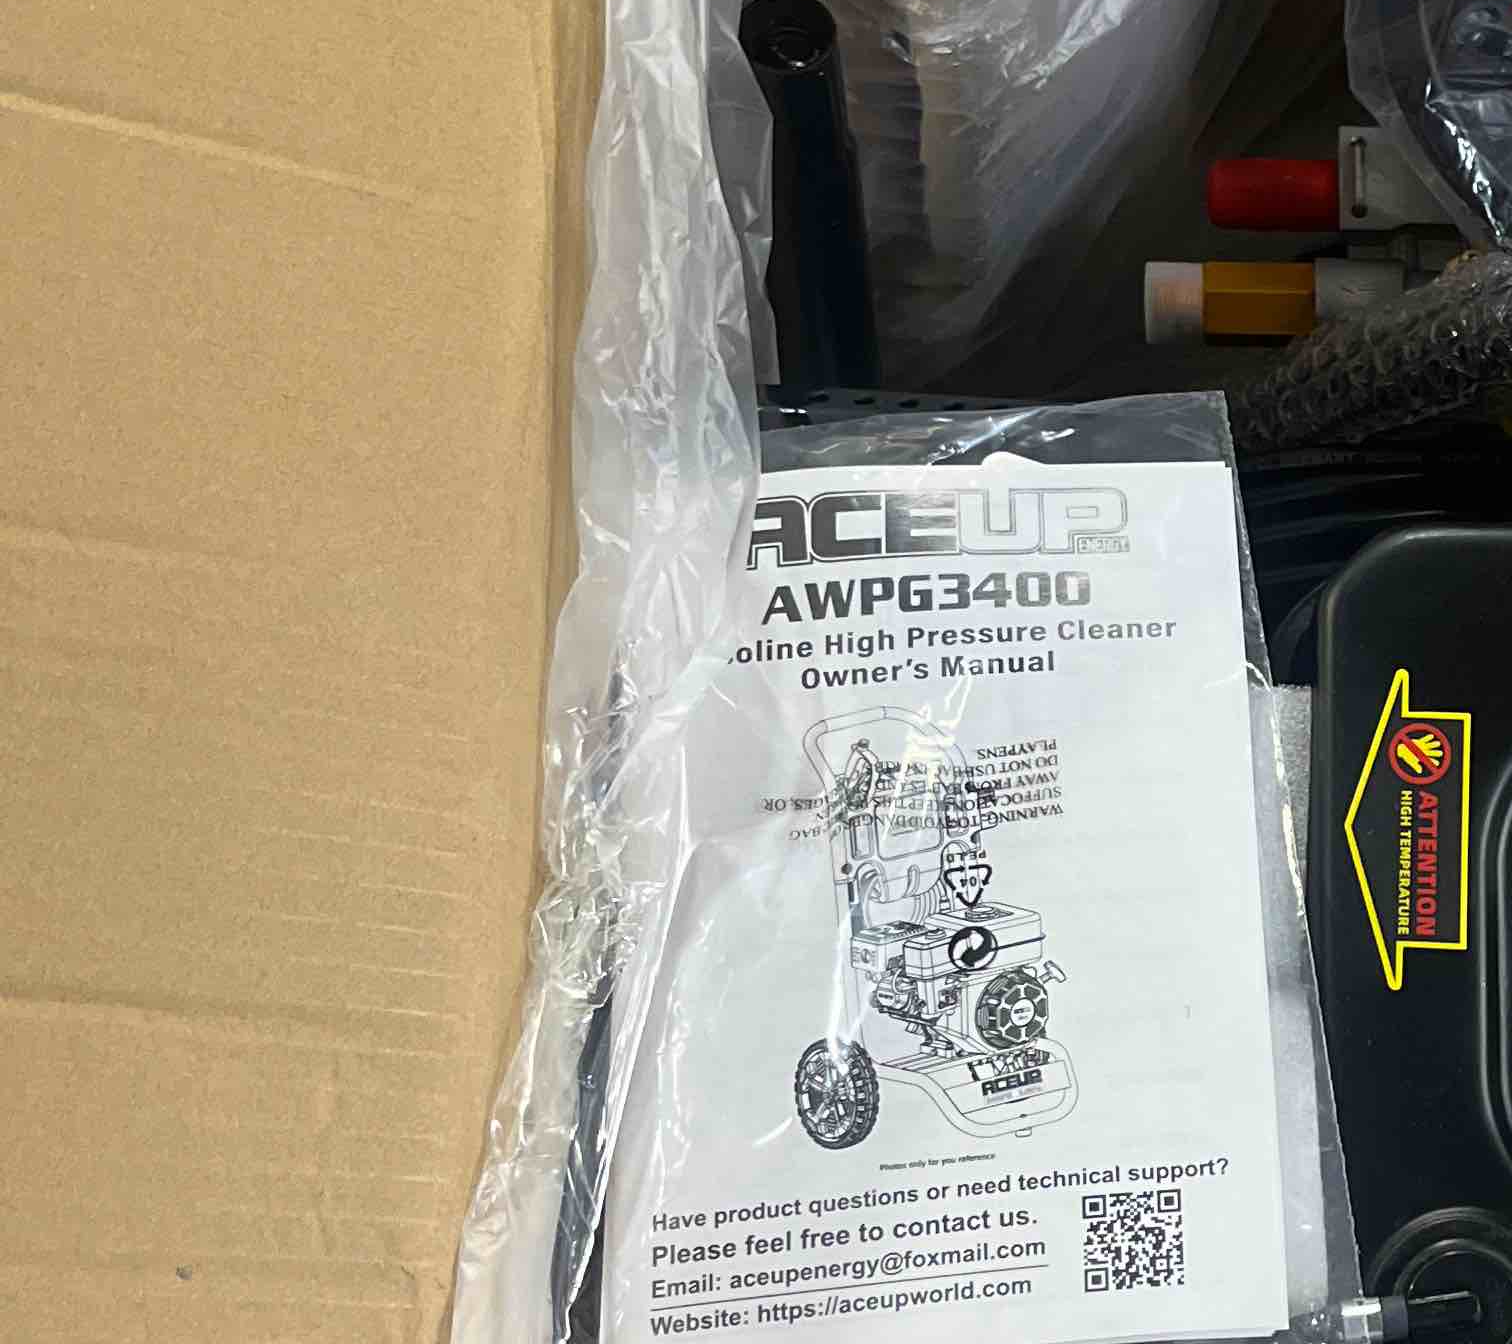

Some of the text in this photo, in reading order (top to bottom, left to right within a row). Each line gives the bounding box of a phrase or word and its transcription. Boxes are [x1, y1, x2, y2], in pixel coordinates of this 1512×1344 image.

[745, 487, 1128, 570] ACEUP
[761, 570, 1092, 625] AWPG3400
[727, 618, 1177, 665] oline High Pressure Cleaner
[800, 650, 1055, 690] Owner's Manual
[977, 738, 1057, 760] PLAYPENS
[1000, 757, 1033, 773] NOT
[1035, 754, 1058, 767] DO
[1017, 770, 1060, 786] AWAY
[1397, 790, 1412, 936] HIGH TEMPERATURE
[1415, 791, 1439, 936] ATTENTION
[652, 1157, 1230, 1233] Have product questions or need technical support?
[651, 1208, 1038, 1268] Please feel free to contact us.
[651, 1239, 1046, 1299] Email: aceupenergy@foxmail.com
[650, 1277, 1033, 1336] Website: https://aceupworld.com
